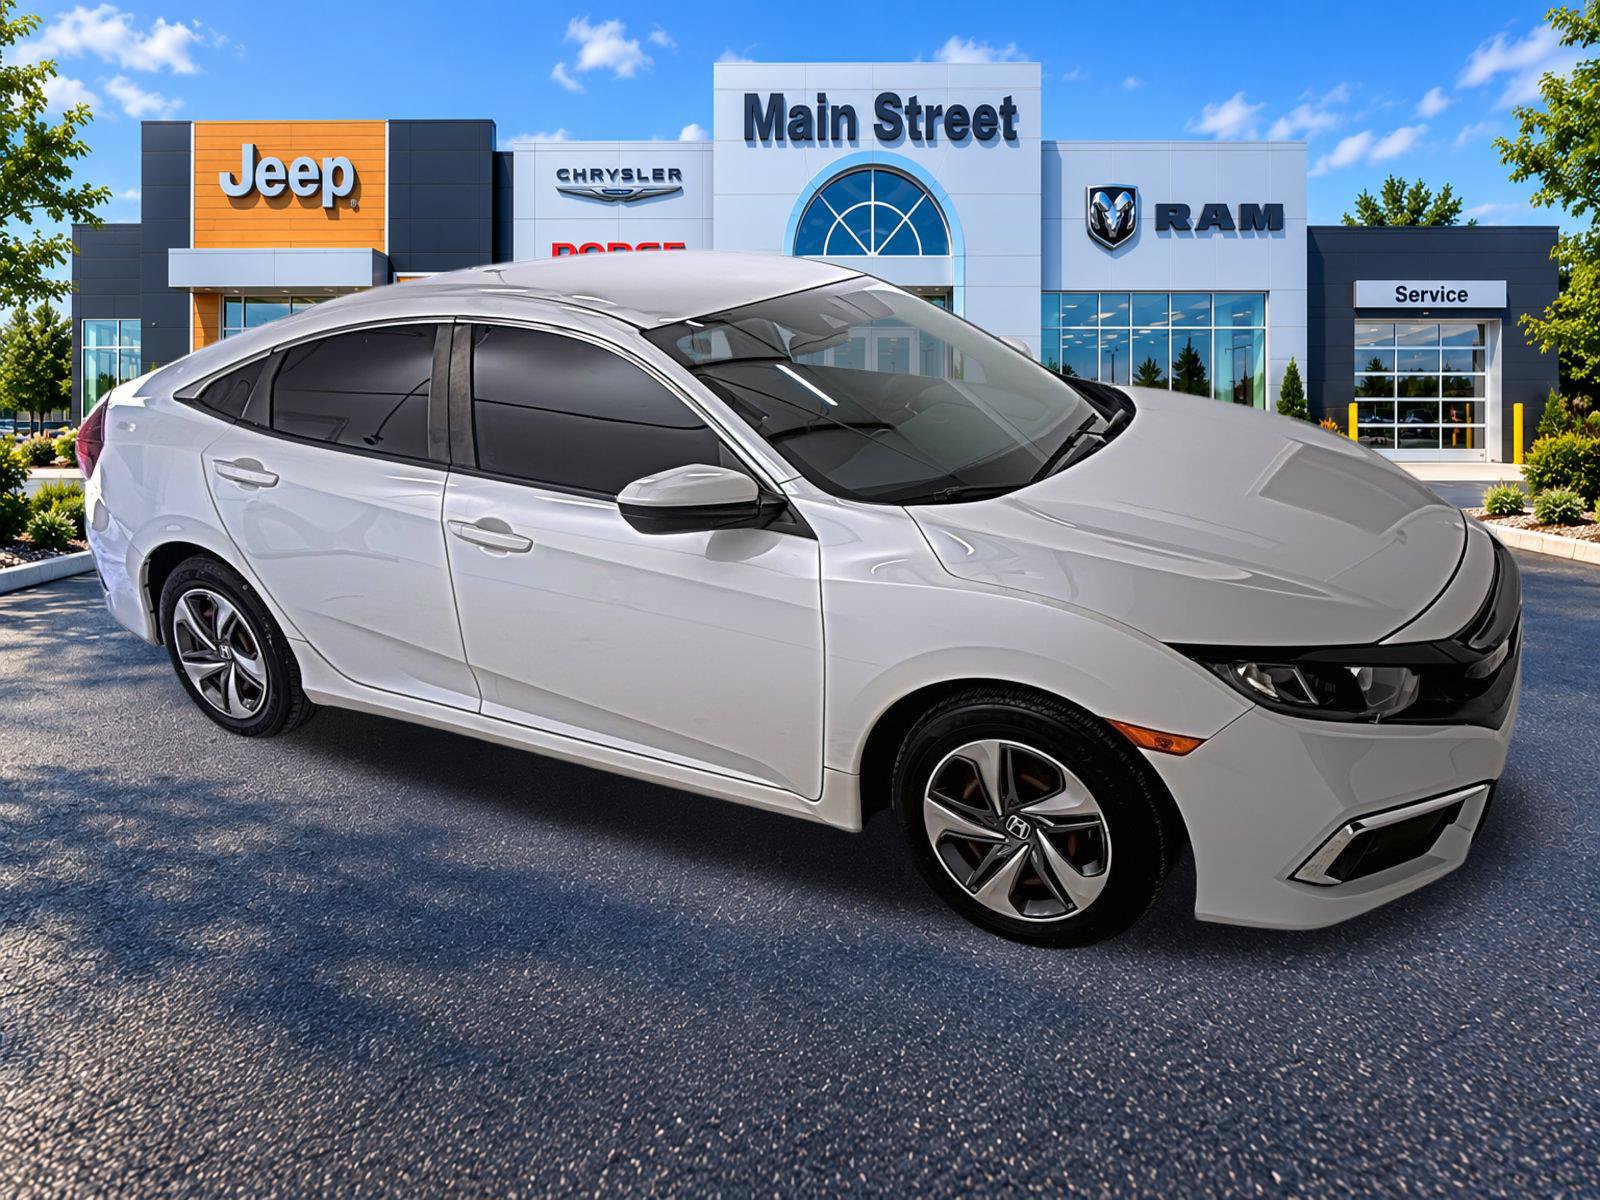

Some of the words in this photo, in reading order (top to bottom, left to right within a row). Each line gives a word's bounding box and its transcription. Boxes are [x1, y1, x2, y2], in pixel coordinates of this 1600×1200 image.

[743, 92, 857, 141] Main
[873, 91, 1018, 141] Street
[218, 143, 355, 209] Jeep
[556, 168, 683, 182] CHRYSLER
[1155, 203, 1284, 231] RAM
[1395, 285, 1468, 303] Service
